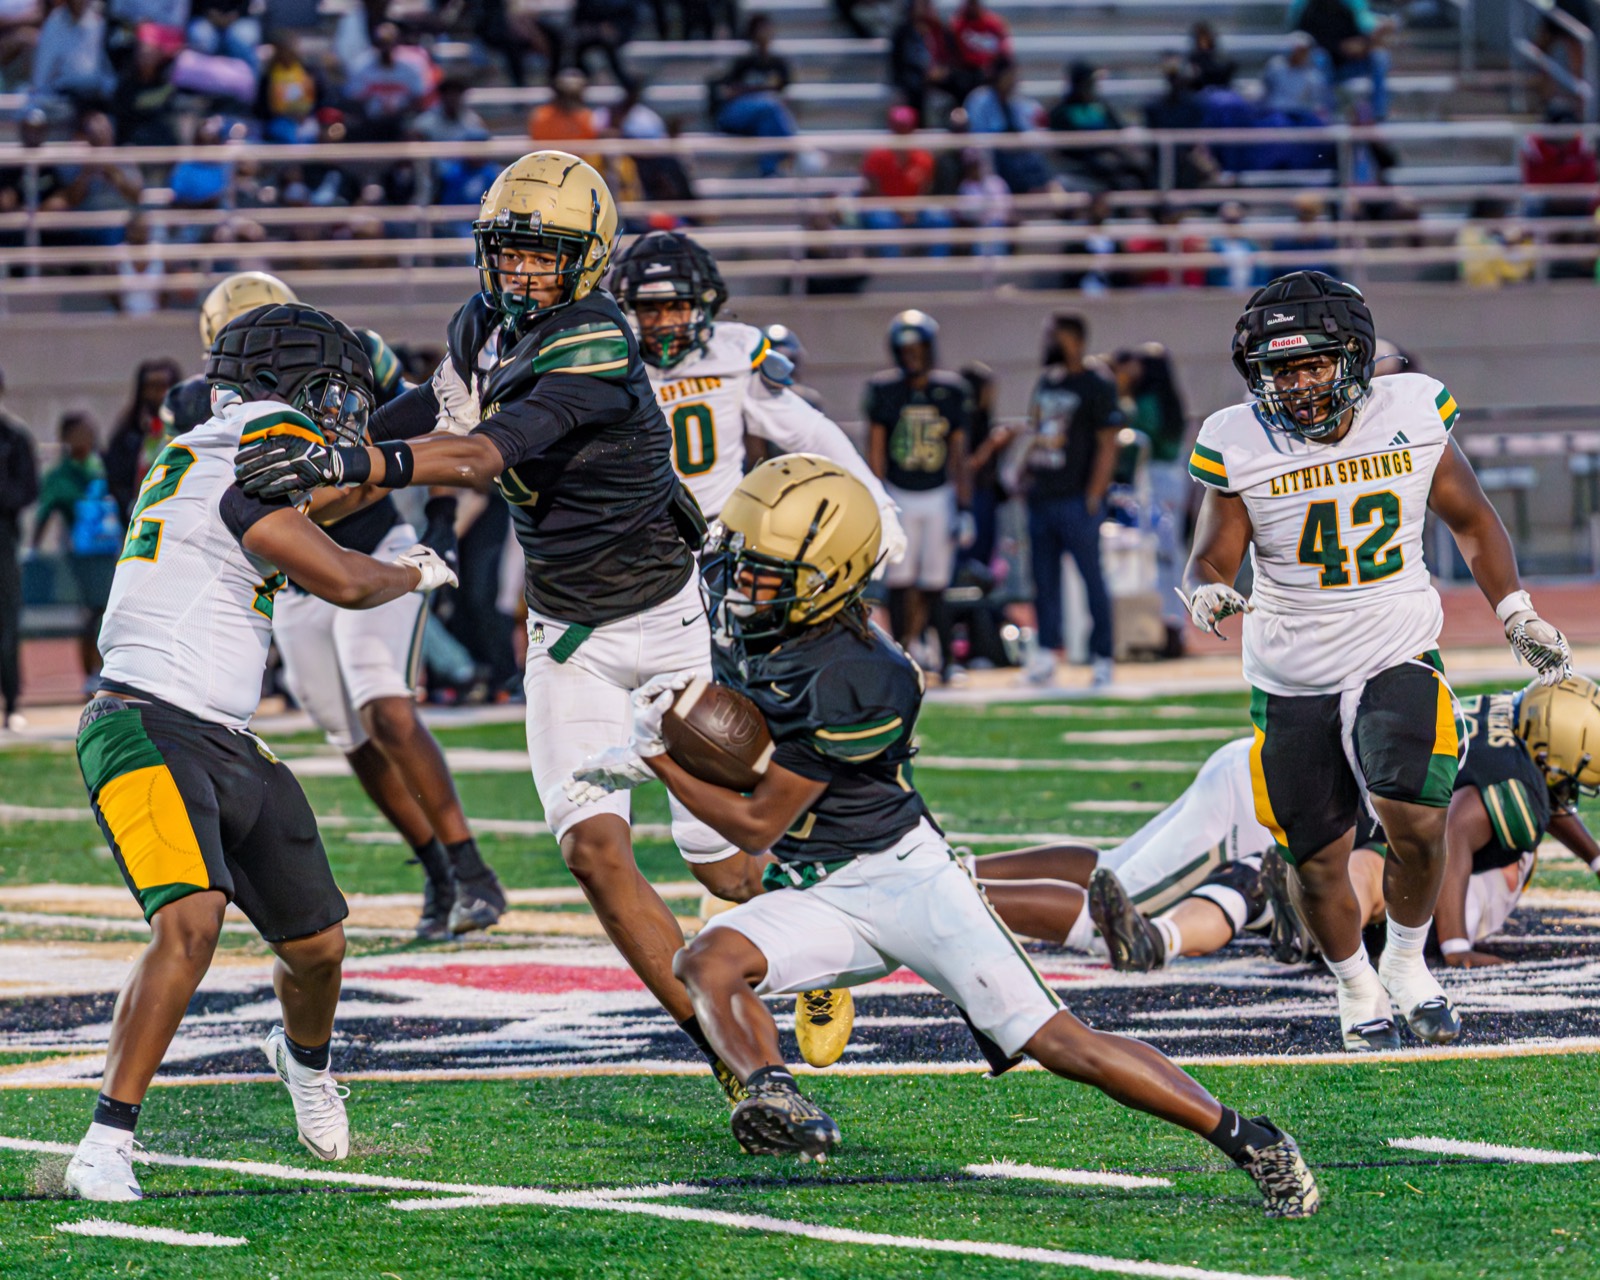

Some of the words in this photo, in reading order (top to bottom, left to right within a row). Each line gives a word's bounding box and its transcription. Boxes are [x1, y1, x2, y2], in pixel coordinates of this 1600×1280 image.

[1271, 336, 1302, 348] Riddell
[116, 443, 198, 567] 2
[1270, 464, 1336, 497] LITHIA
[1337, 449, 1413, 485] SPRINGS
[1296, 489, 1405, 590] 42
